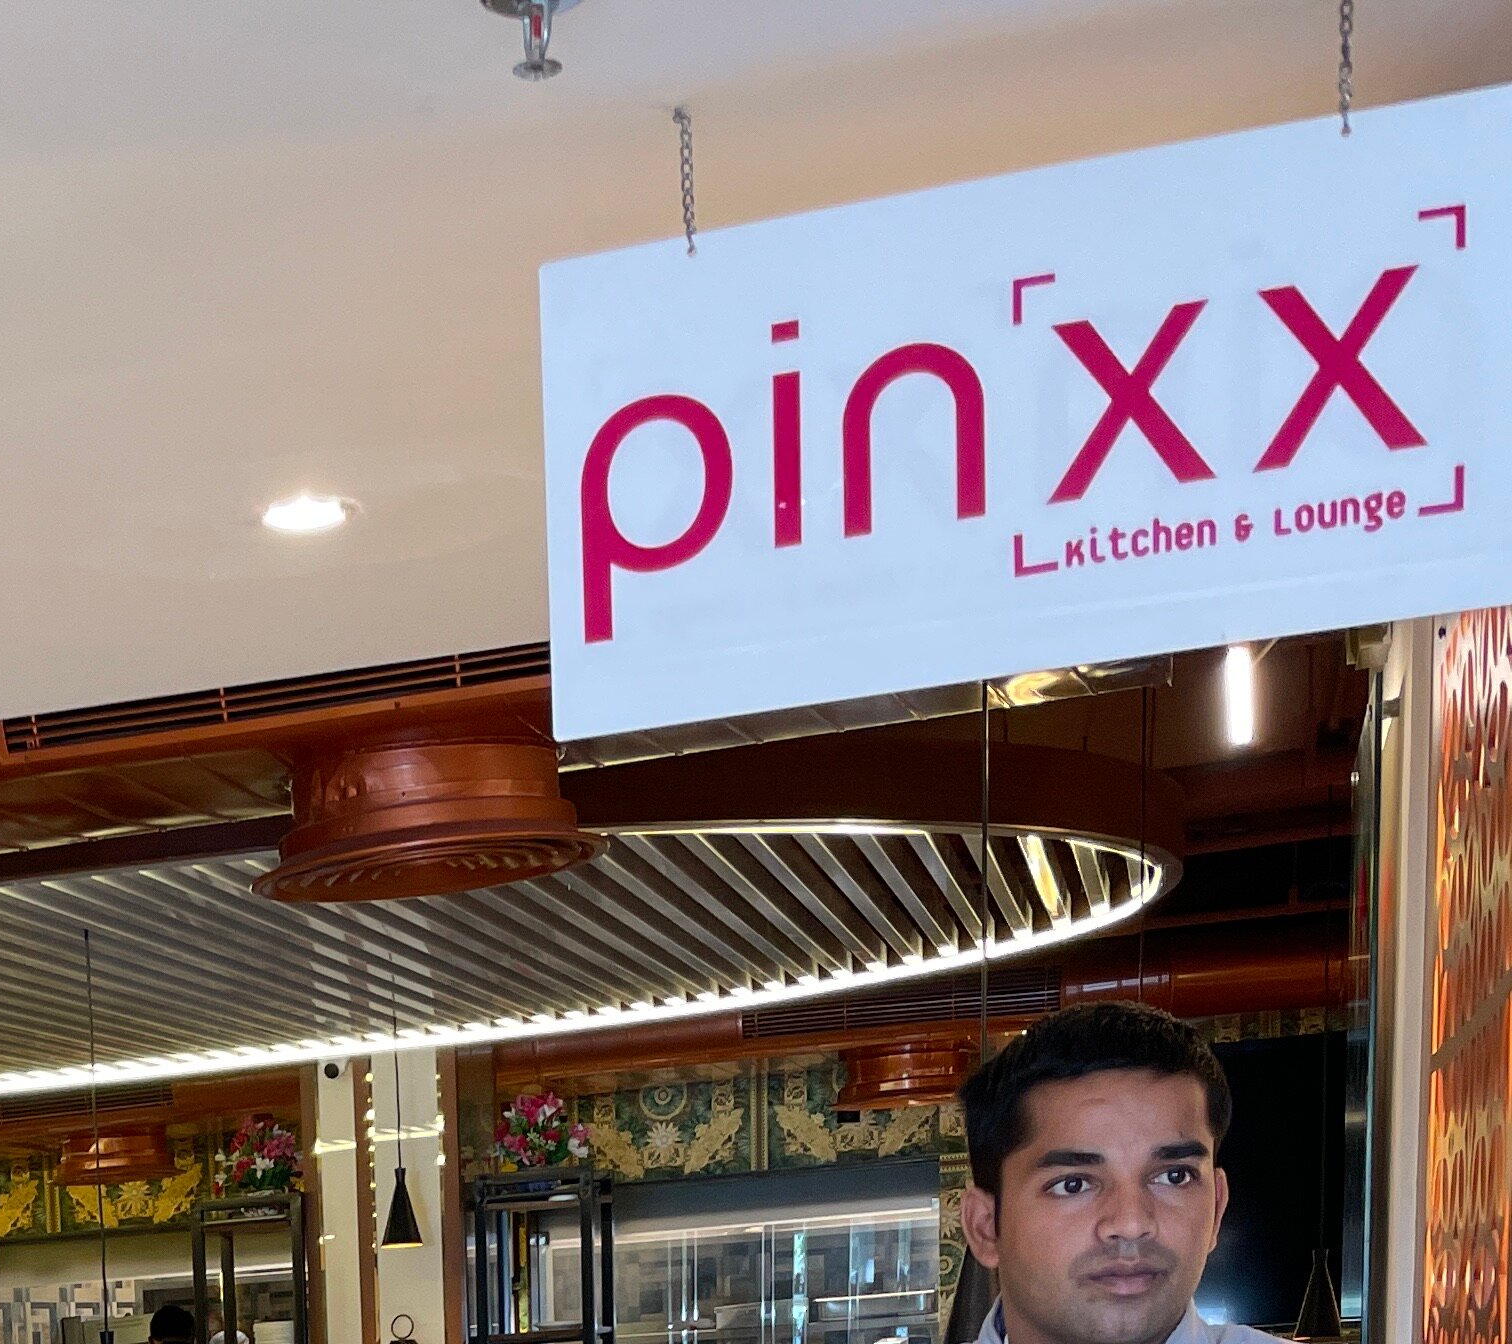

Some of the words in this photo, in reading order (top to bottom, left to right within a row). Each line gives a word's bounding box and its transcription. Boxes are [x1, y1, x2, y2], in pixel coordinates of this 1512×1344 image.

[1064, 517, 1217, 568] Kitchen
[1234, 513, 1254, 542] &
[1273, 490, 1407, 533] Lounge
